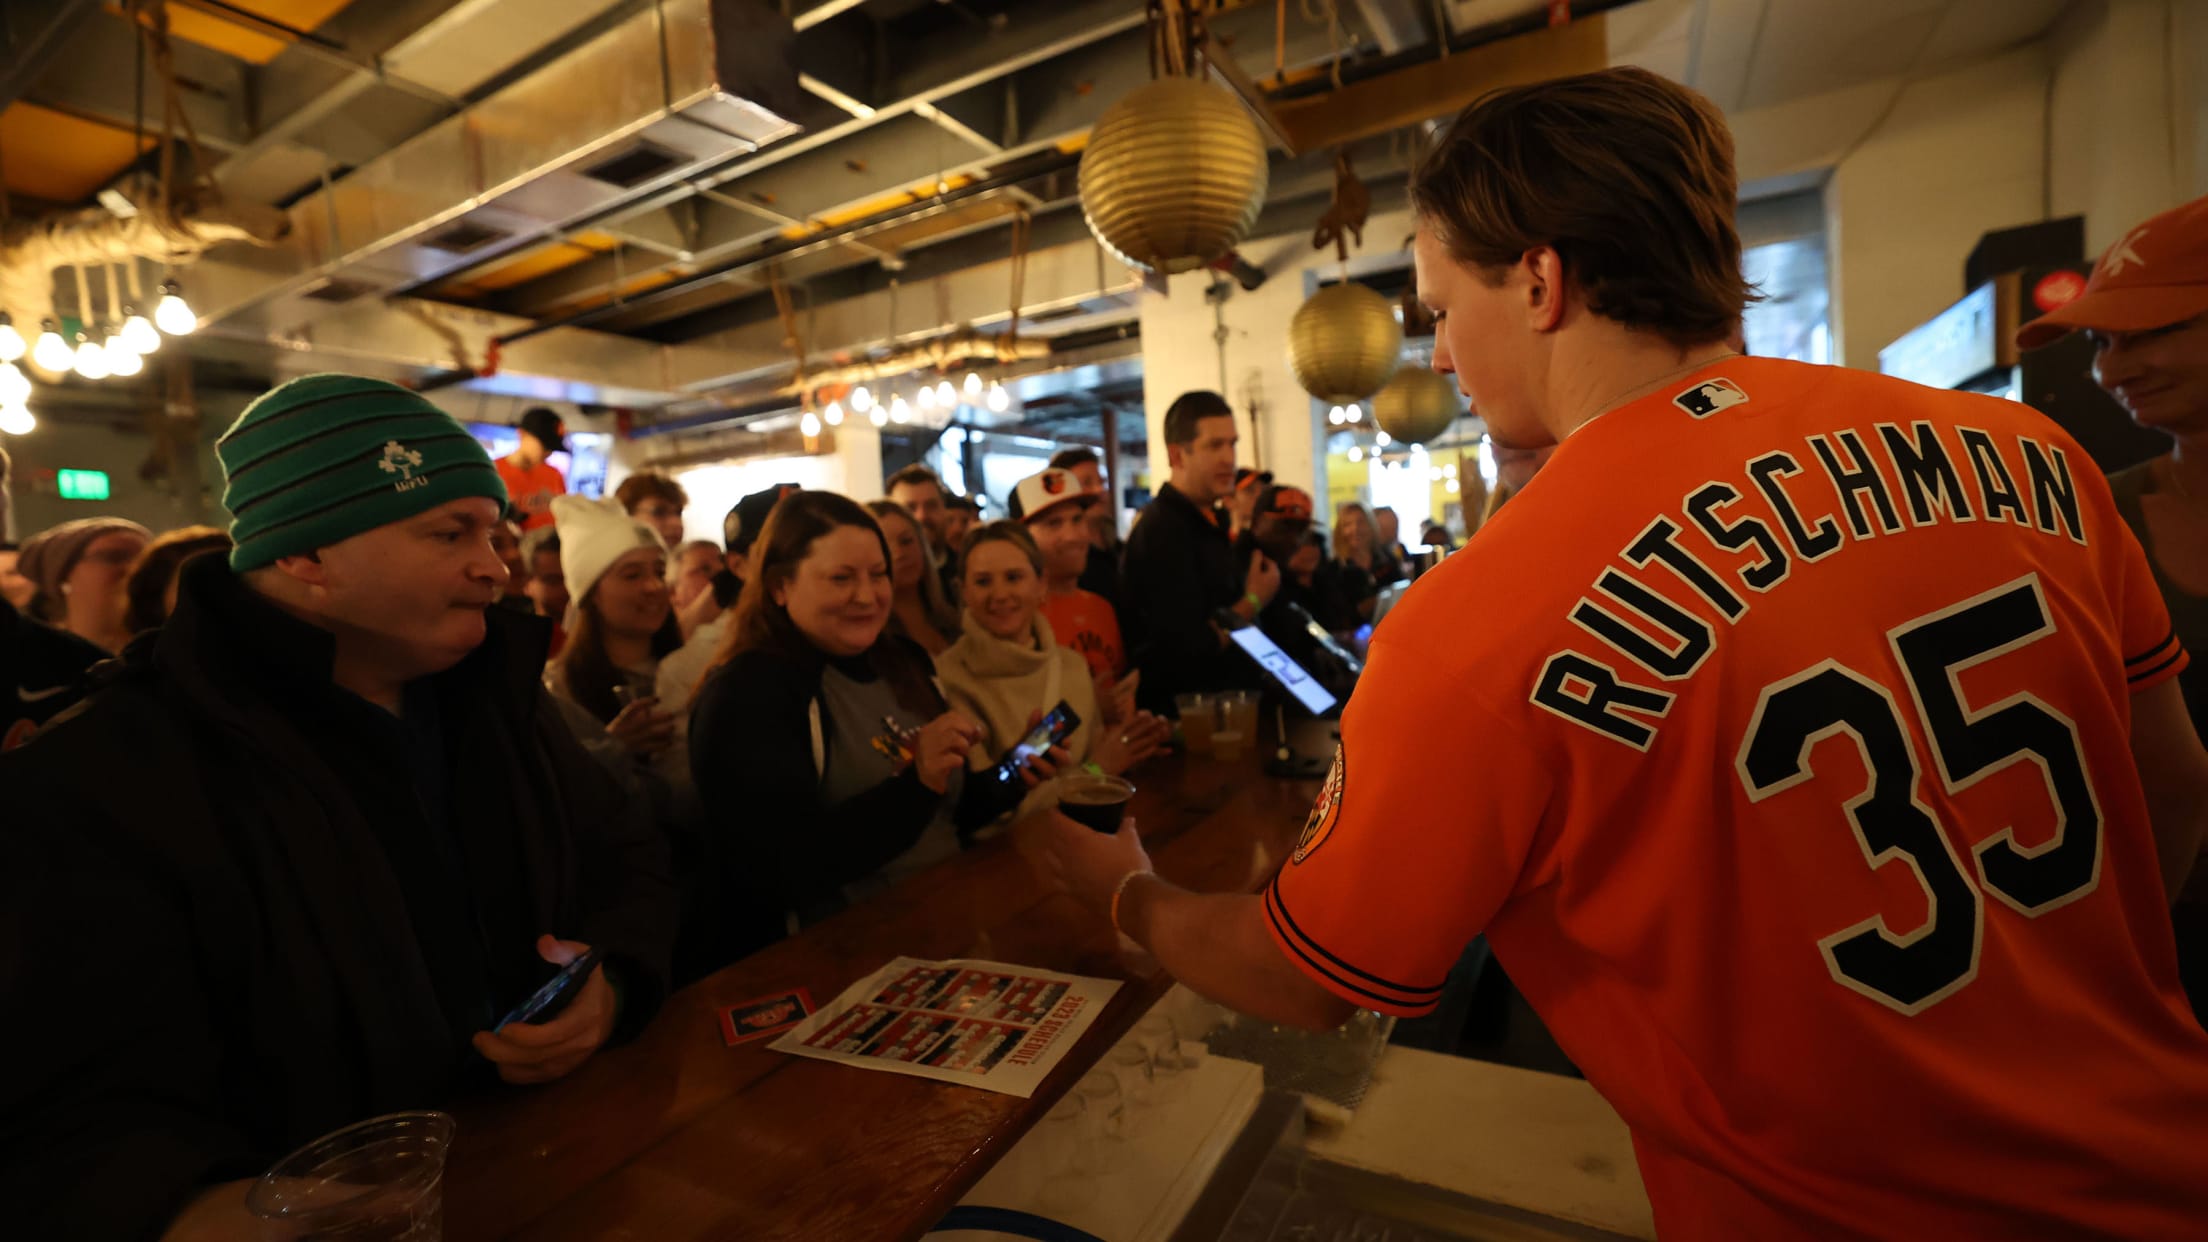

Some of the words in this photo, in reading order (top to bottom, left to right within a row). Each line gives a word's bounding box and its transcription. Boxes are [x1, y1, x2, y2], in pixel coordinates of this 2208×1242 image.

[1529, 419, 2087, 753] RUTSCHMAN
[1735, 572, 2104, 1017] 35
[1007, 1020, 1063, 1066] SCHEDULE
[1051, 996, 1084, 1019] 2023
